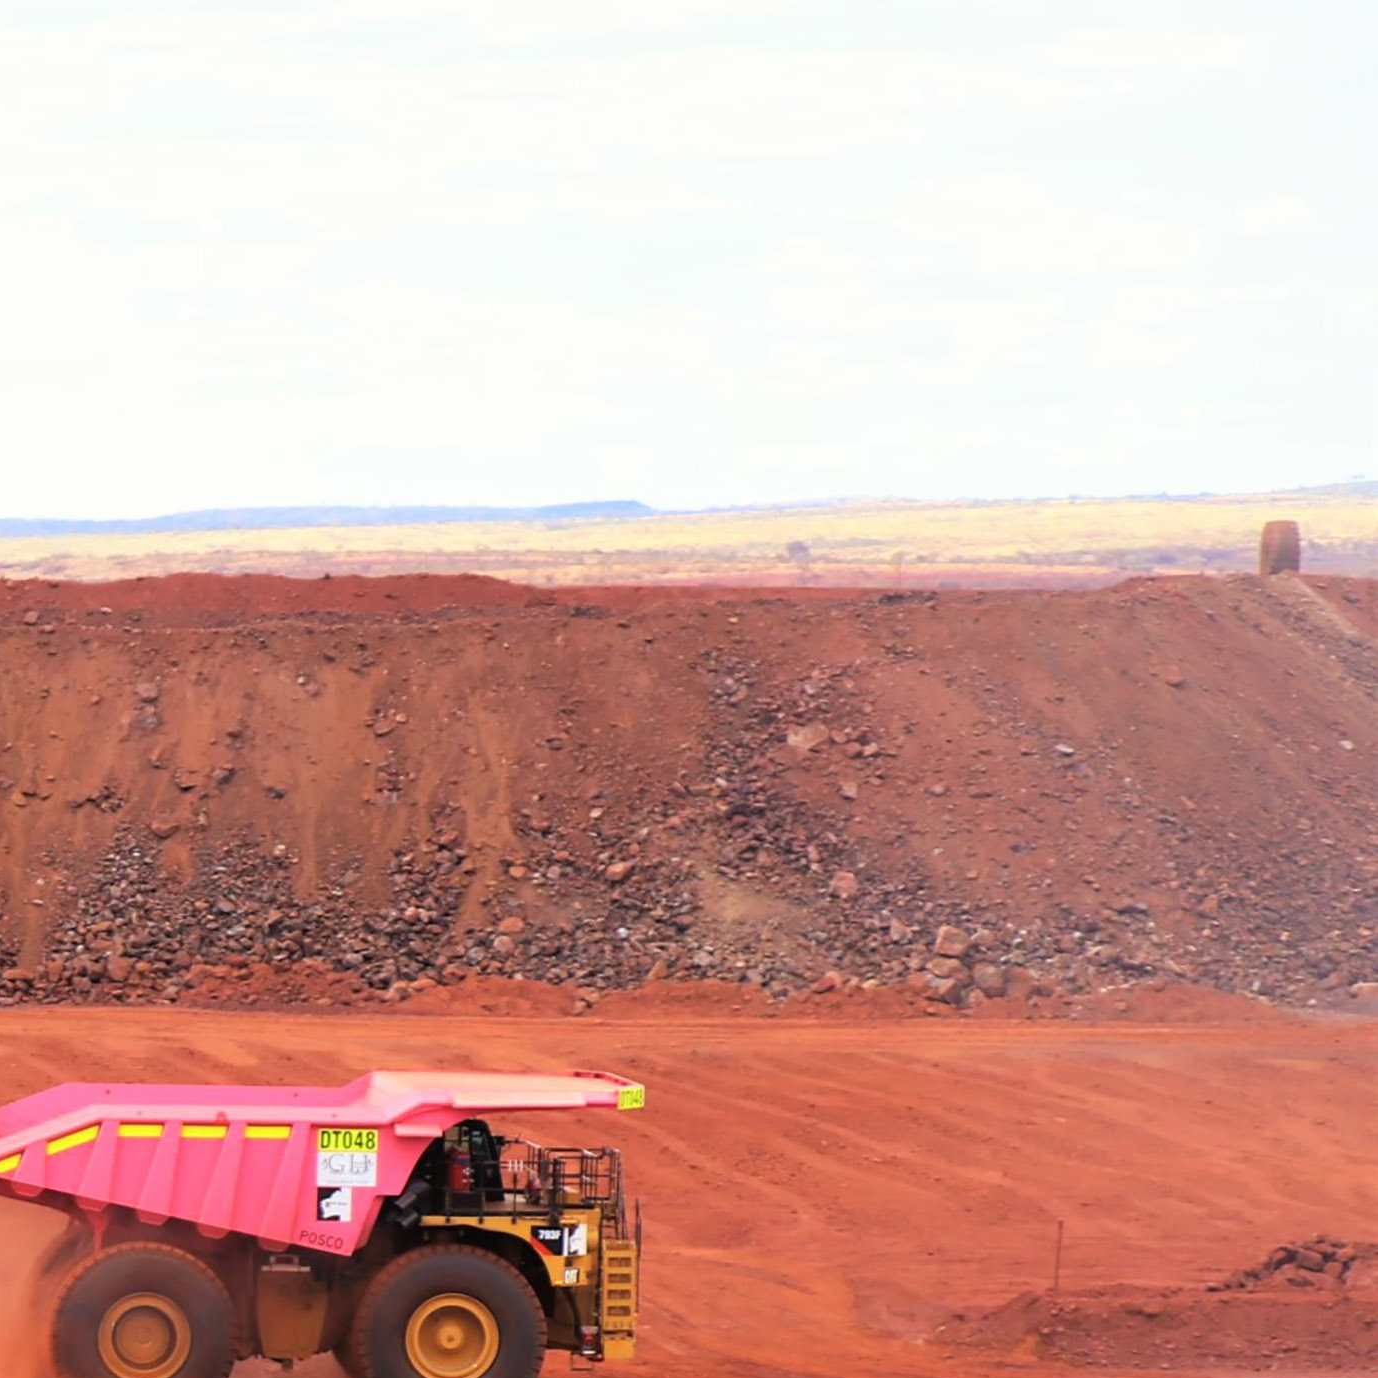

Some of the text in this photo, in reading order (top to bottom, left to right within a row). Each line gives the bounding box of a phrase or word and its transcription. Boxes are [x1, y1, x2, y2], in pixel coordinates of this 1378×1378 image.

[620, 1088, 643, 1107] DT048
[320, 1130, 376, 1150] DT048
[300, 1230, 344, 1250] POSCO
